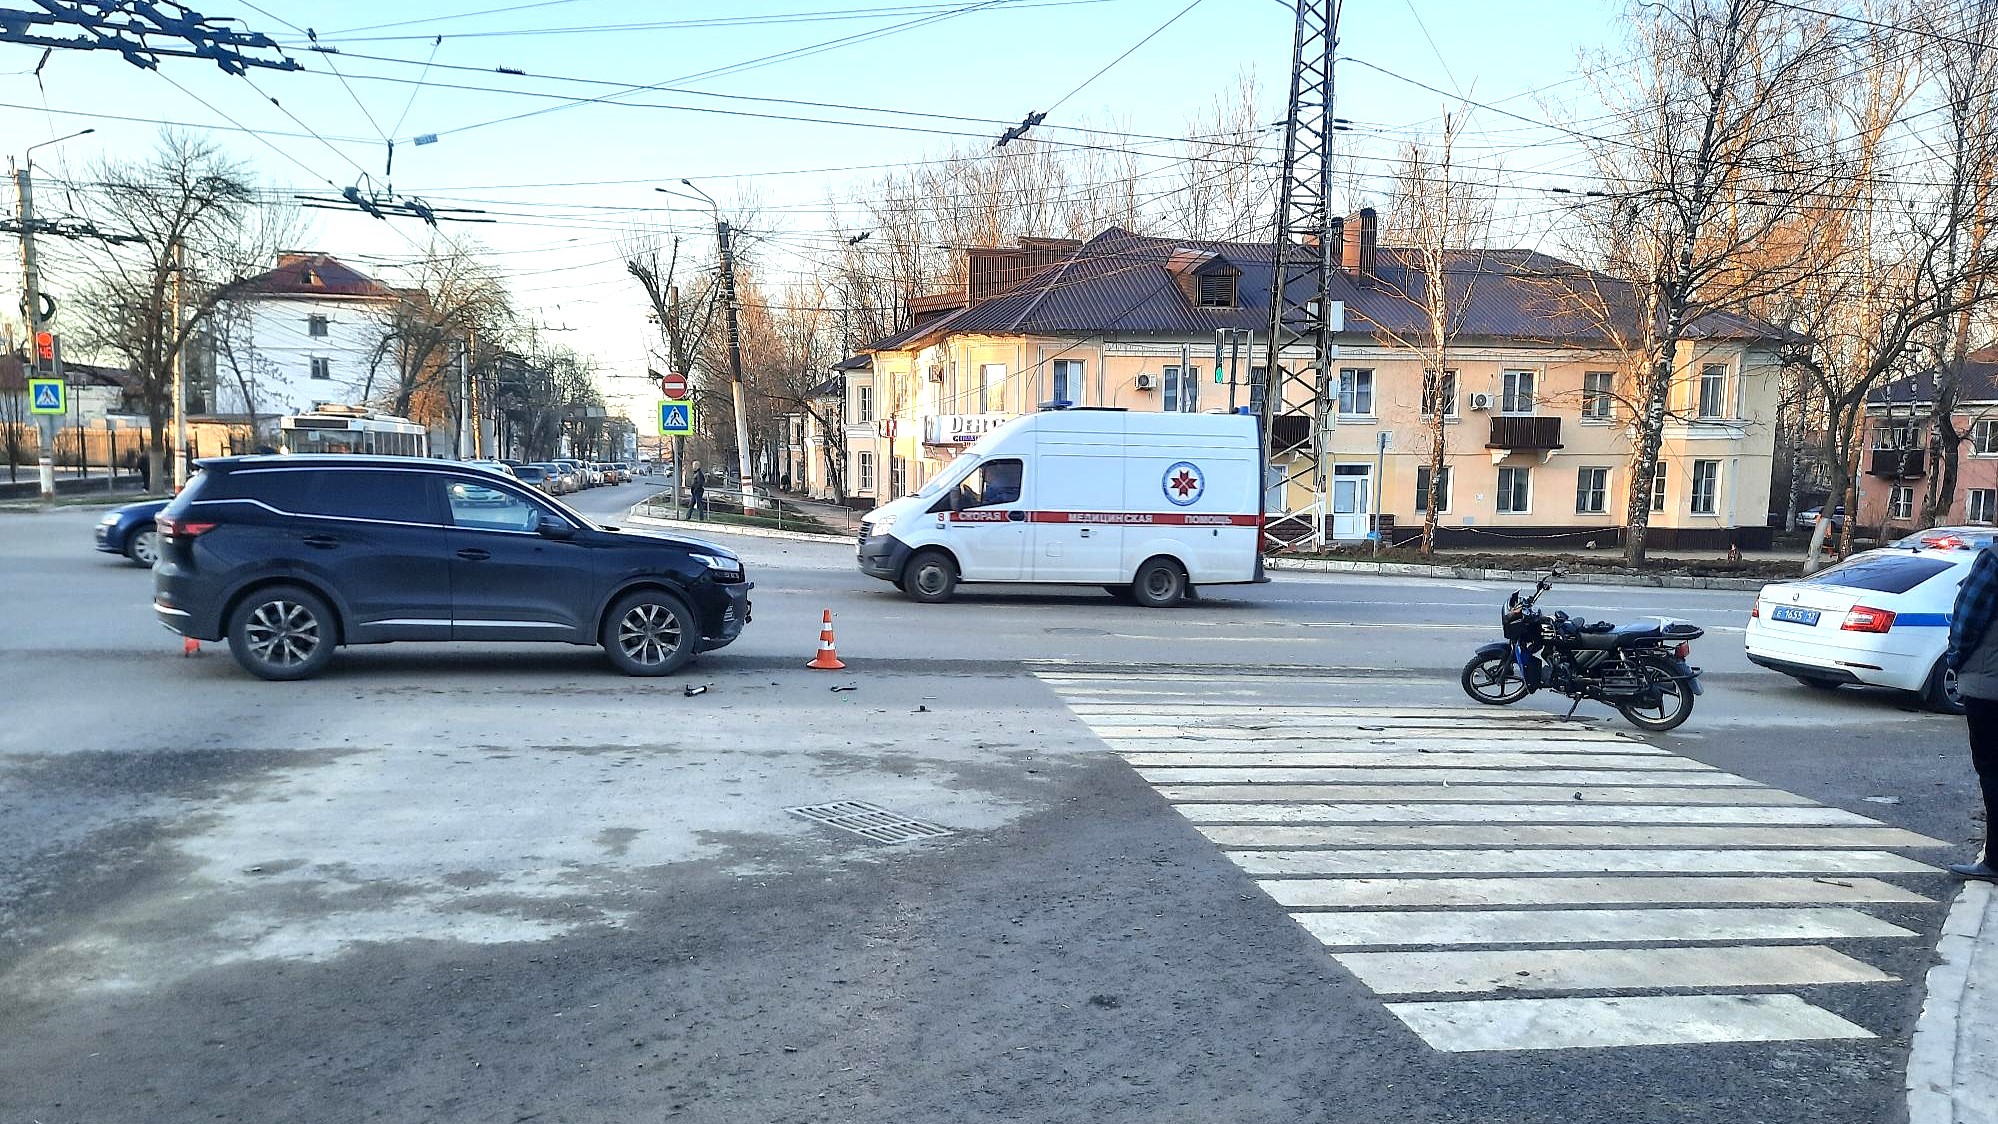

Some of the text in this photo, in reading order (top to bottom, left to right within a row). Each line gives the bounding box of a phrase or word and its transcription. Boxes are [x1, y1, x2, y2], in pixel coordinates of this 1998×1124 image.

[958, 511, 1233, 525] СКОРАЯ МЕДИЦИНСКАЯ ПОМОЩЬ
